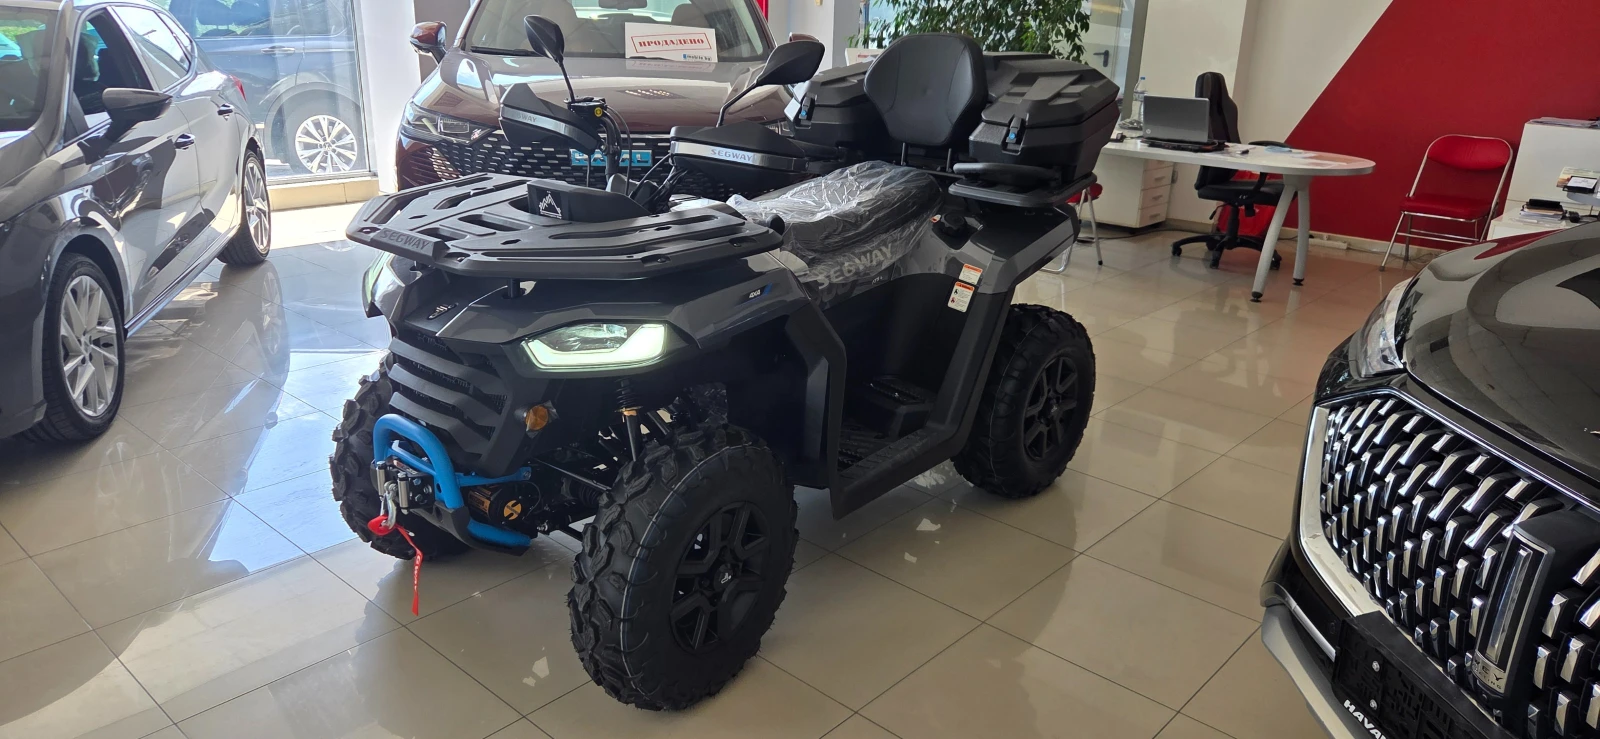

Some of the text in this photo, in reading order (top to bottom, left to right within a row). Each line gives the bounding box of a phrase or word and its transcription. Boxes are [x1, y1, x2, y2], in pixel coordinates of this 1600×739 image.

[638, 38, 704, 48] ПРОДАДЕНО
[574, 152, 649, 164] HAAL
[711, 149, 752, 161] SEGWAY
[380, 229, 430, 250] SEGWAY
[815, 243, 893, 290] SEGWAY
